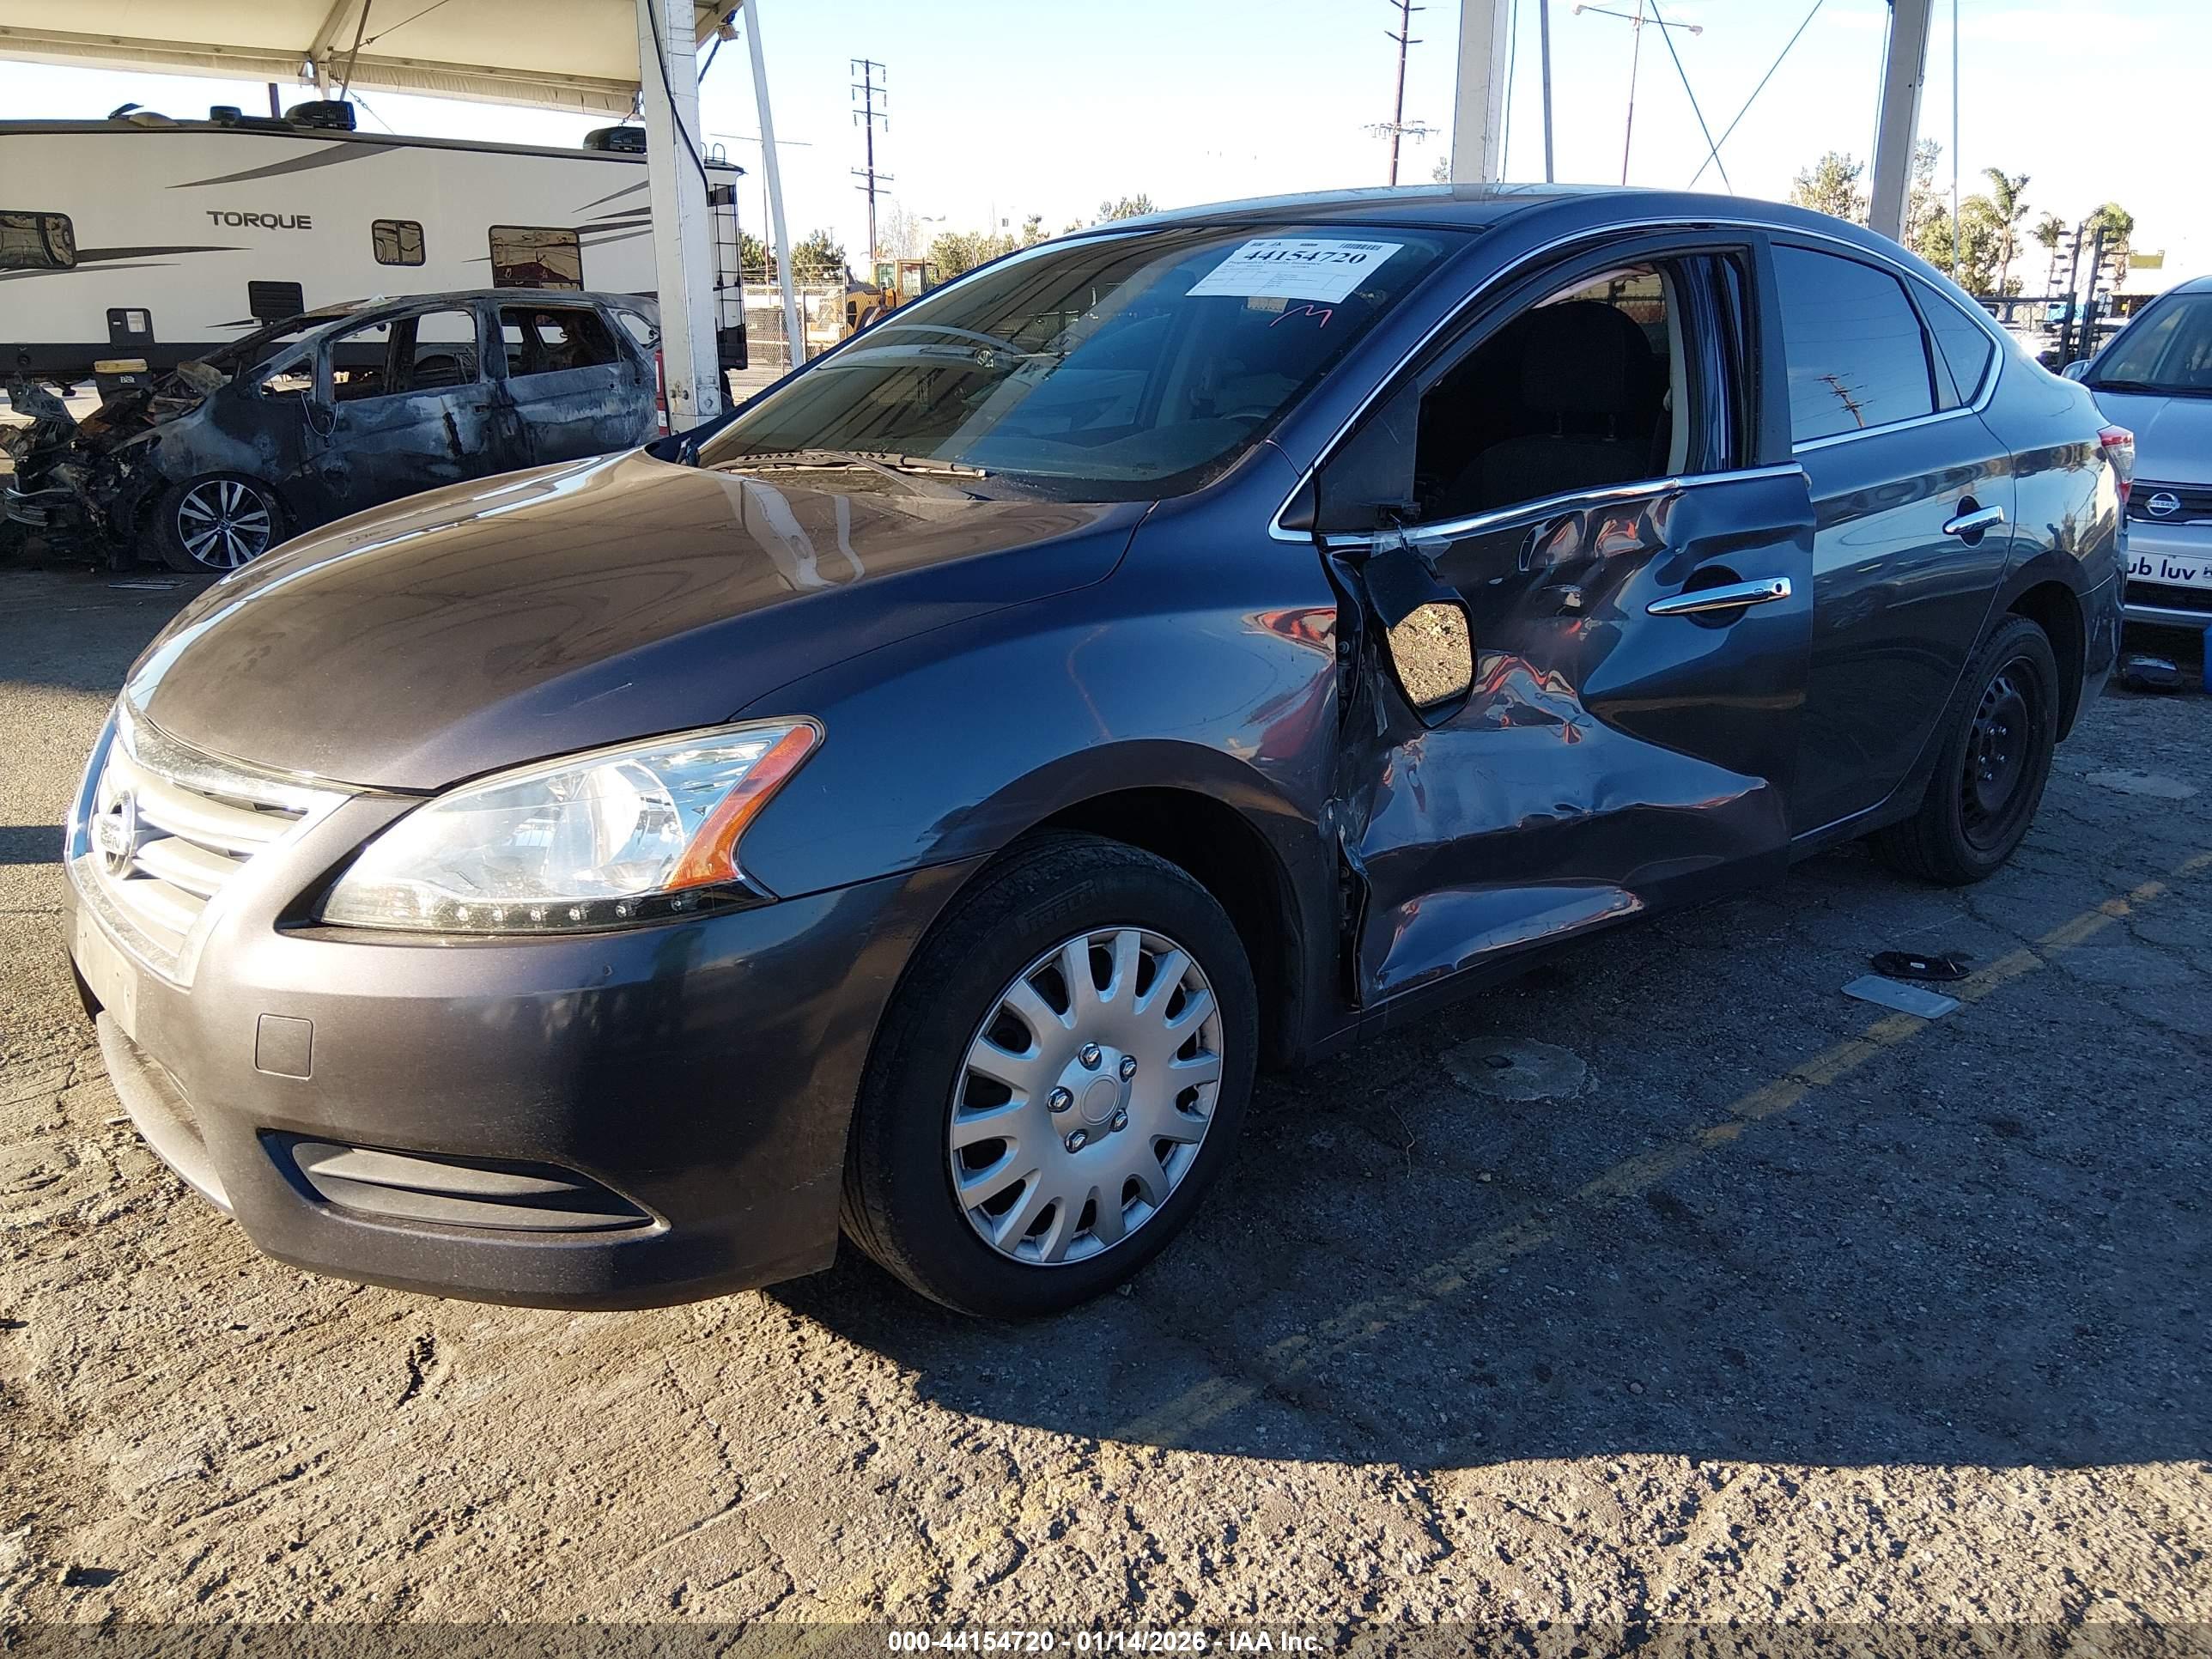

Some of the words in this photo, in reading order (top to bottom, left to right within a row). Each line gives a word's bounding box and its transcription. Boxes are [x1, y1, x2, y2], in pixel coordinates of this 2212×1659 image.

[206, 210, 313, 230] TORQUE
[1243, 250, 1367, 264] 44154720
[2160, 559, 2197, 580] luv
